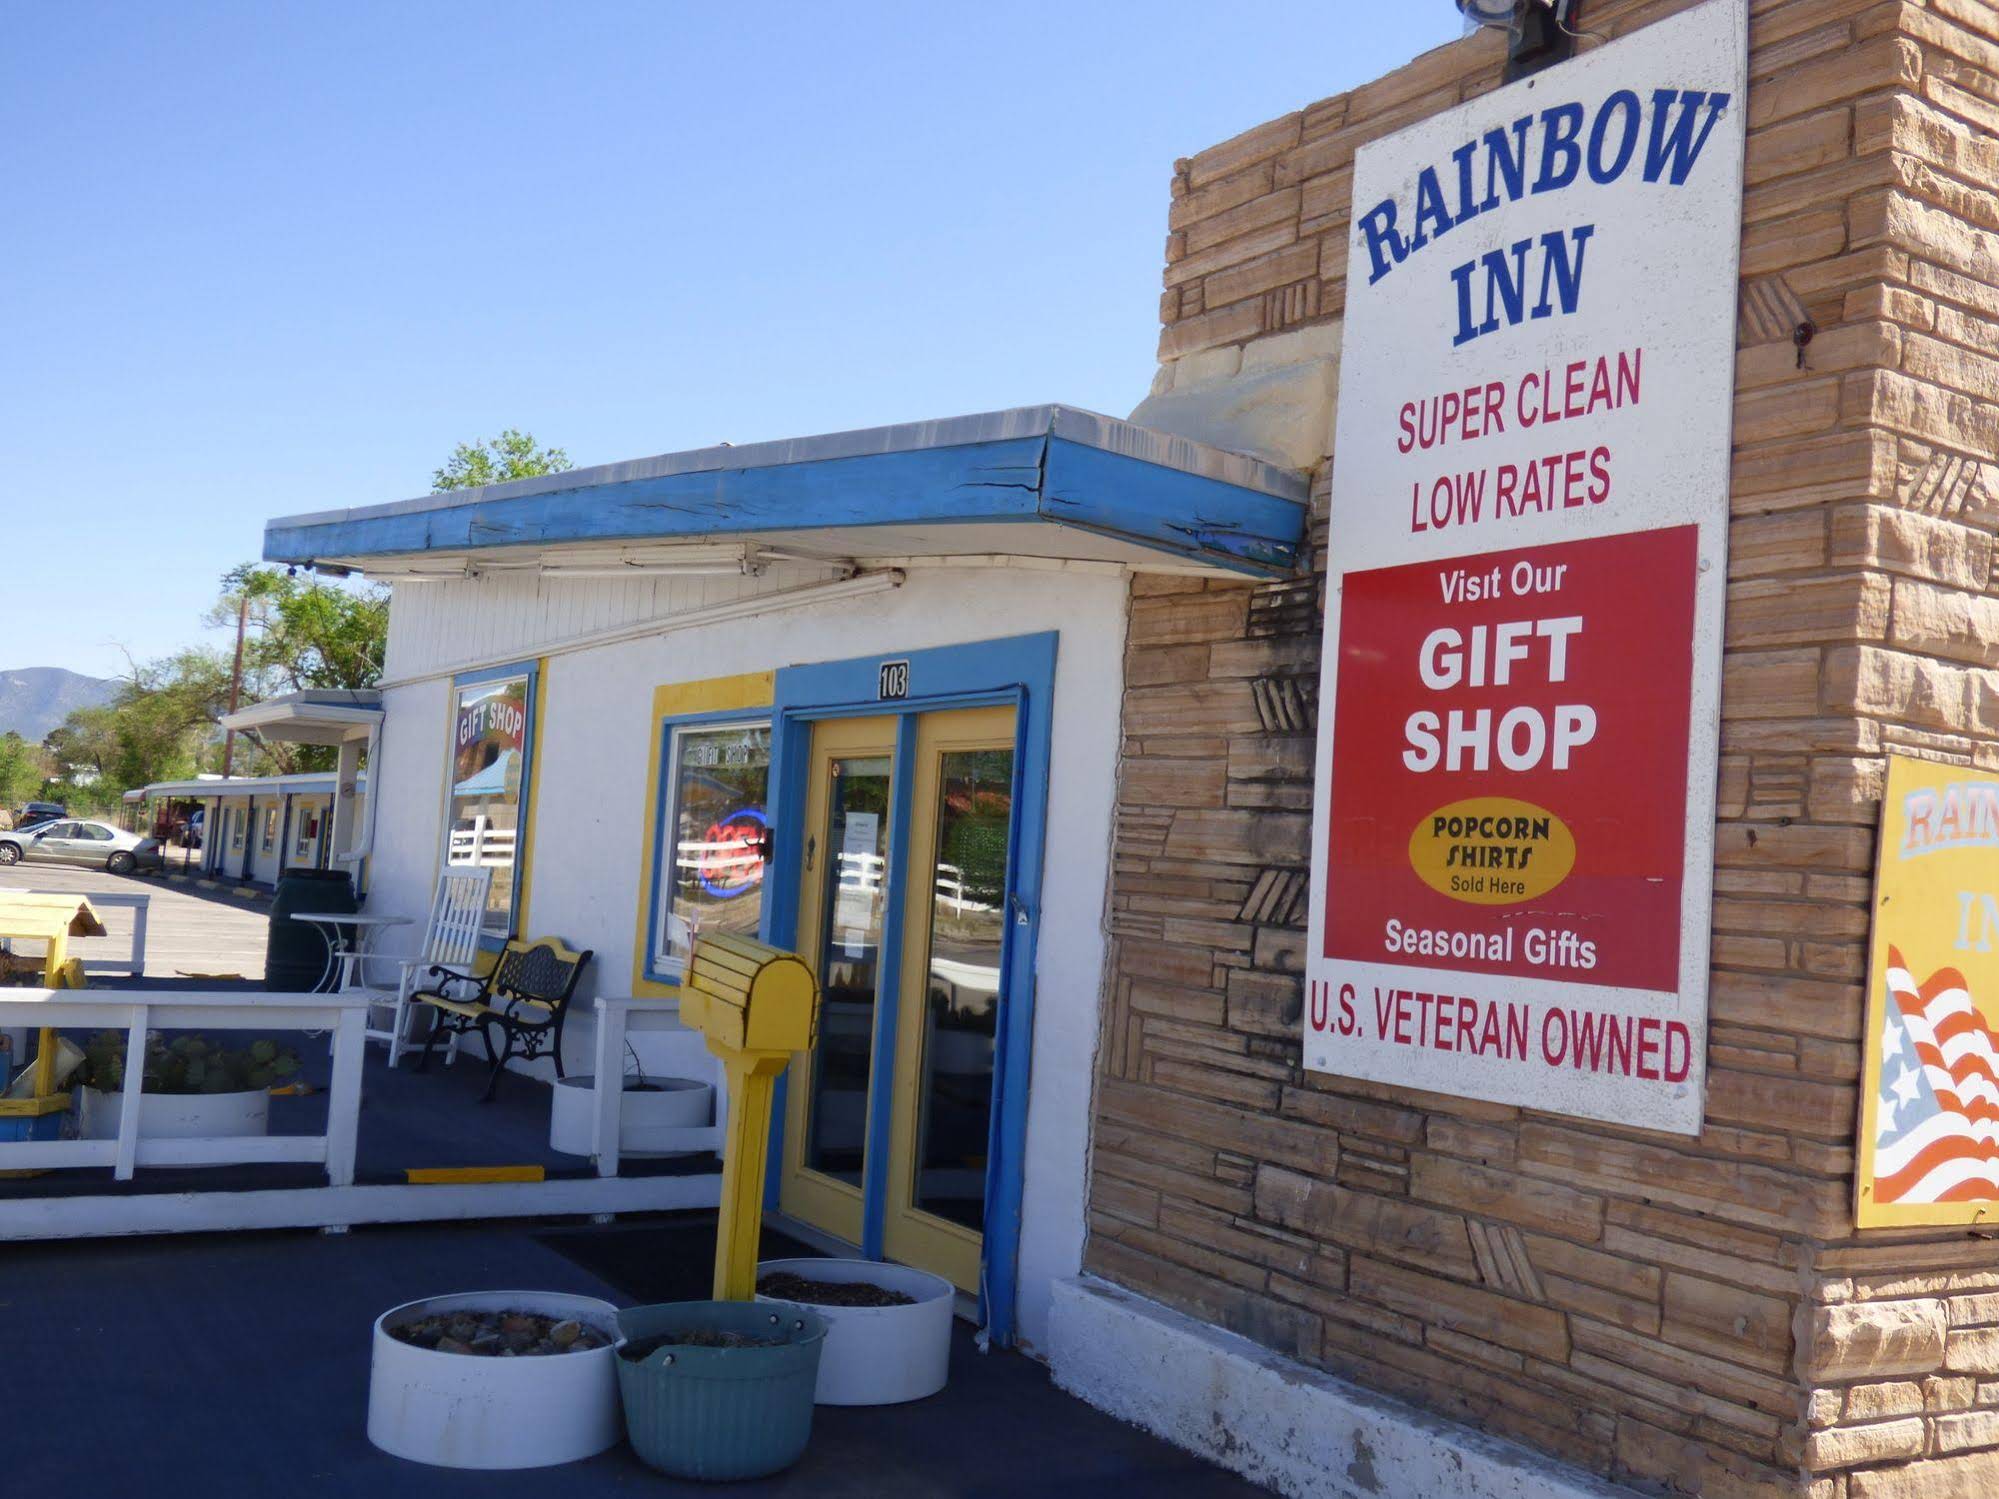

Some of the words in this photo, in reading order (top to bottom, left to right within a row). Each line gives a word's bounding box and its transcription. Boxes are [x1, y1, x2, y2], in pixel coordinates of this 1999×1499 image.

[1358, 88, 1730, 286] RAINBOW
[1450, 224, 1594, 347] INN
[1397, 381, 1505, 454] SUPER
[1517, 348, 1641, 427] CLEAN
[1411, 471, 1484, 533] LOW
[1496, 447, 1611, 519] RATES
[1440, 567, 1500, 604] Visit
[1511, 561, 1567, 596] Our
[882, 665, 906, 697] 103
[1419, 615, 1583, 691] GIFT
[460, 703, 487, 746] GIFT
[489, 702, 522, 739] SHOP
[1402, 704, 1597, 773] SHOP
[1432, 816, 1550, 840] POPCORN
[1446, 844, 1533, 870] SHIRTS
[1451, 875, 1484, 893] Sold
[1490, 876, 1525, 895] Here
[1385, 918, 1513, 962] Seasonal
[1524, 928, 1597, 969] Gifts
[1310, 980, 1363, 1038] U.S.
[1374, 987, 1529, 1062] VETERAN
[1542, 1007, 1692, 1083] OWNED
